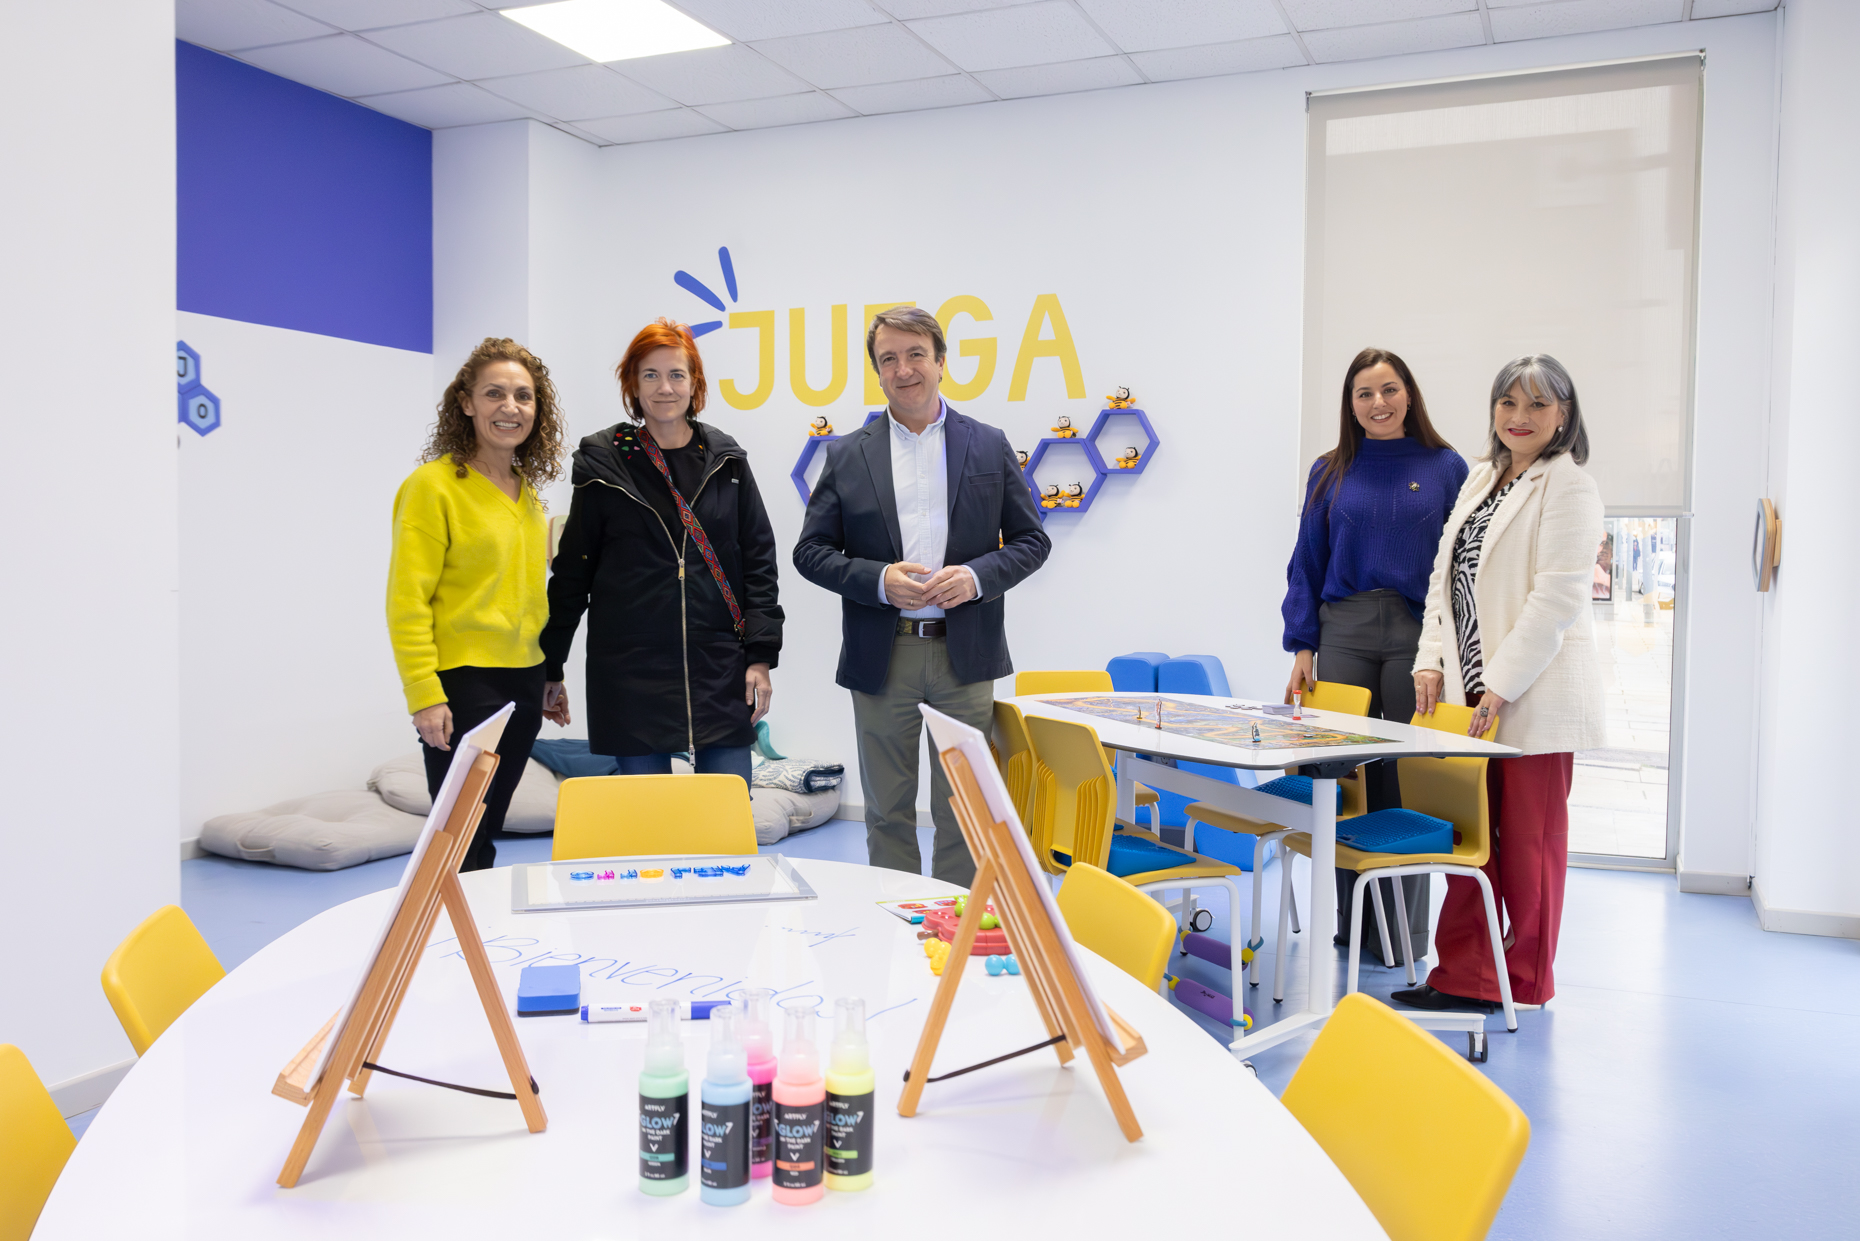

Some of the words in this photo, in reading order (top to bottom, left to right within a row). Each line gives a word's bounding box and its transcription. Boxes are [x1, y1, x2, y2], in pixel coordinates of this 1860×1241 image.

[640, 1114, 674, 1129] GLOW
[702, 1121, 726, 1137] LOW
[779, 1124, 814, 1138] GLOW
